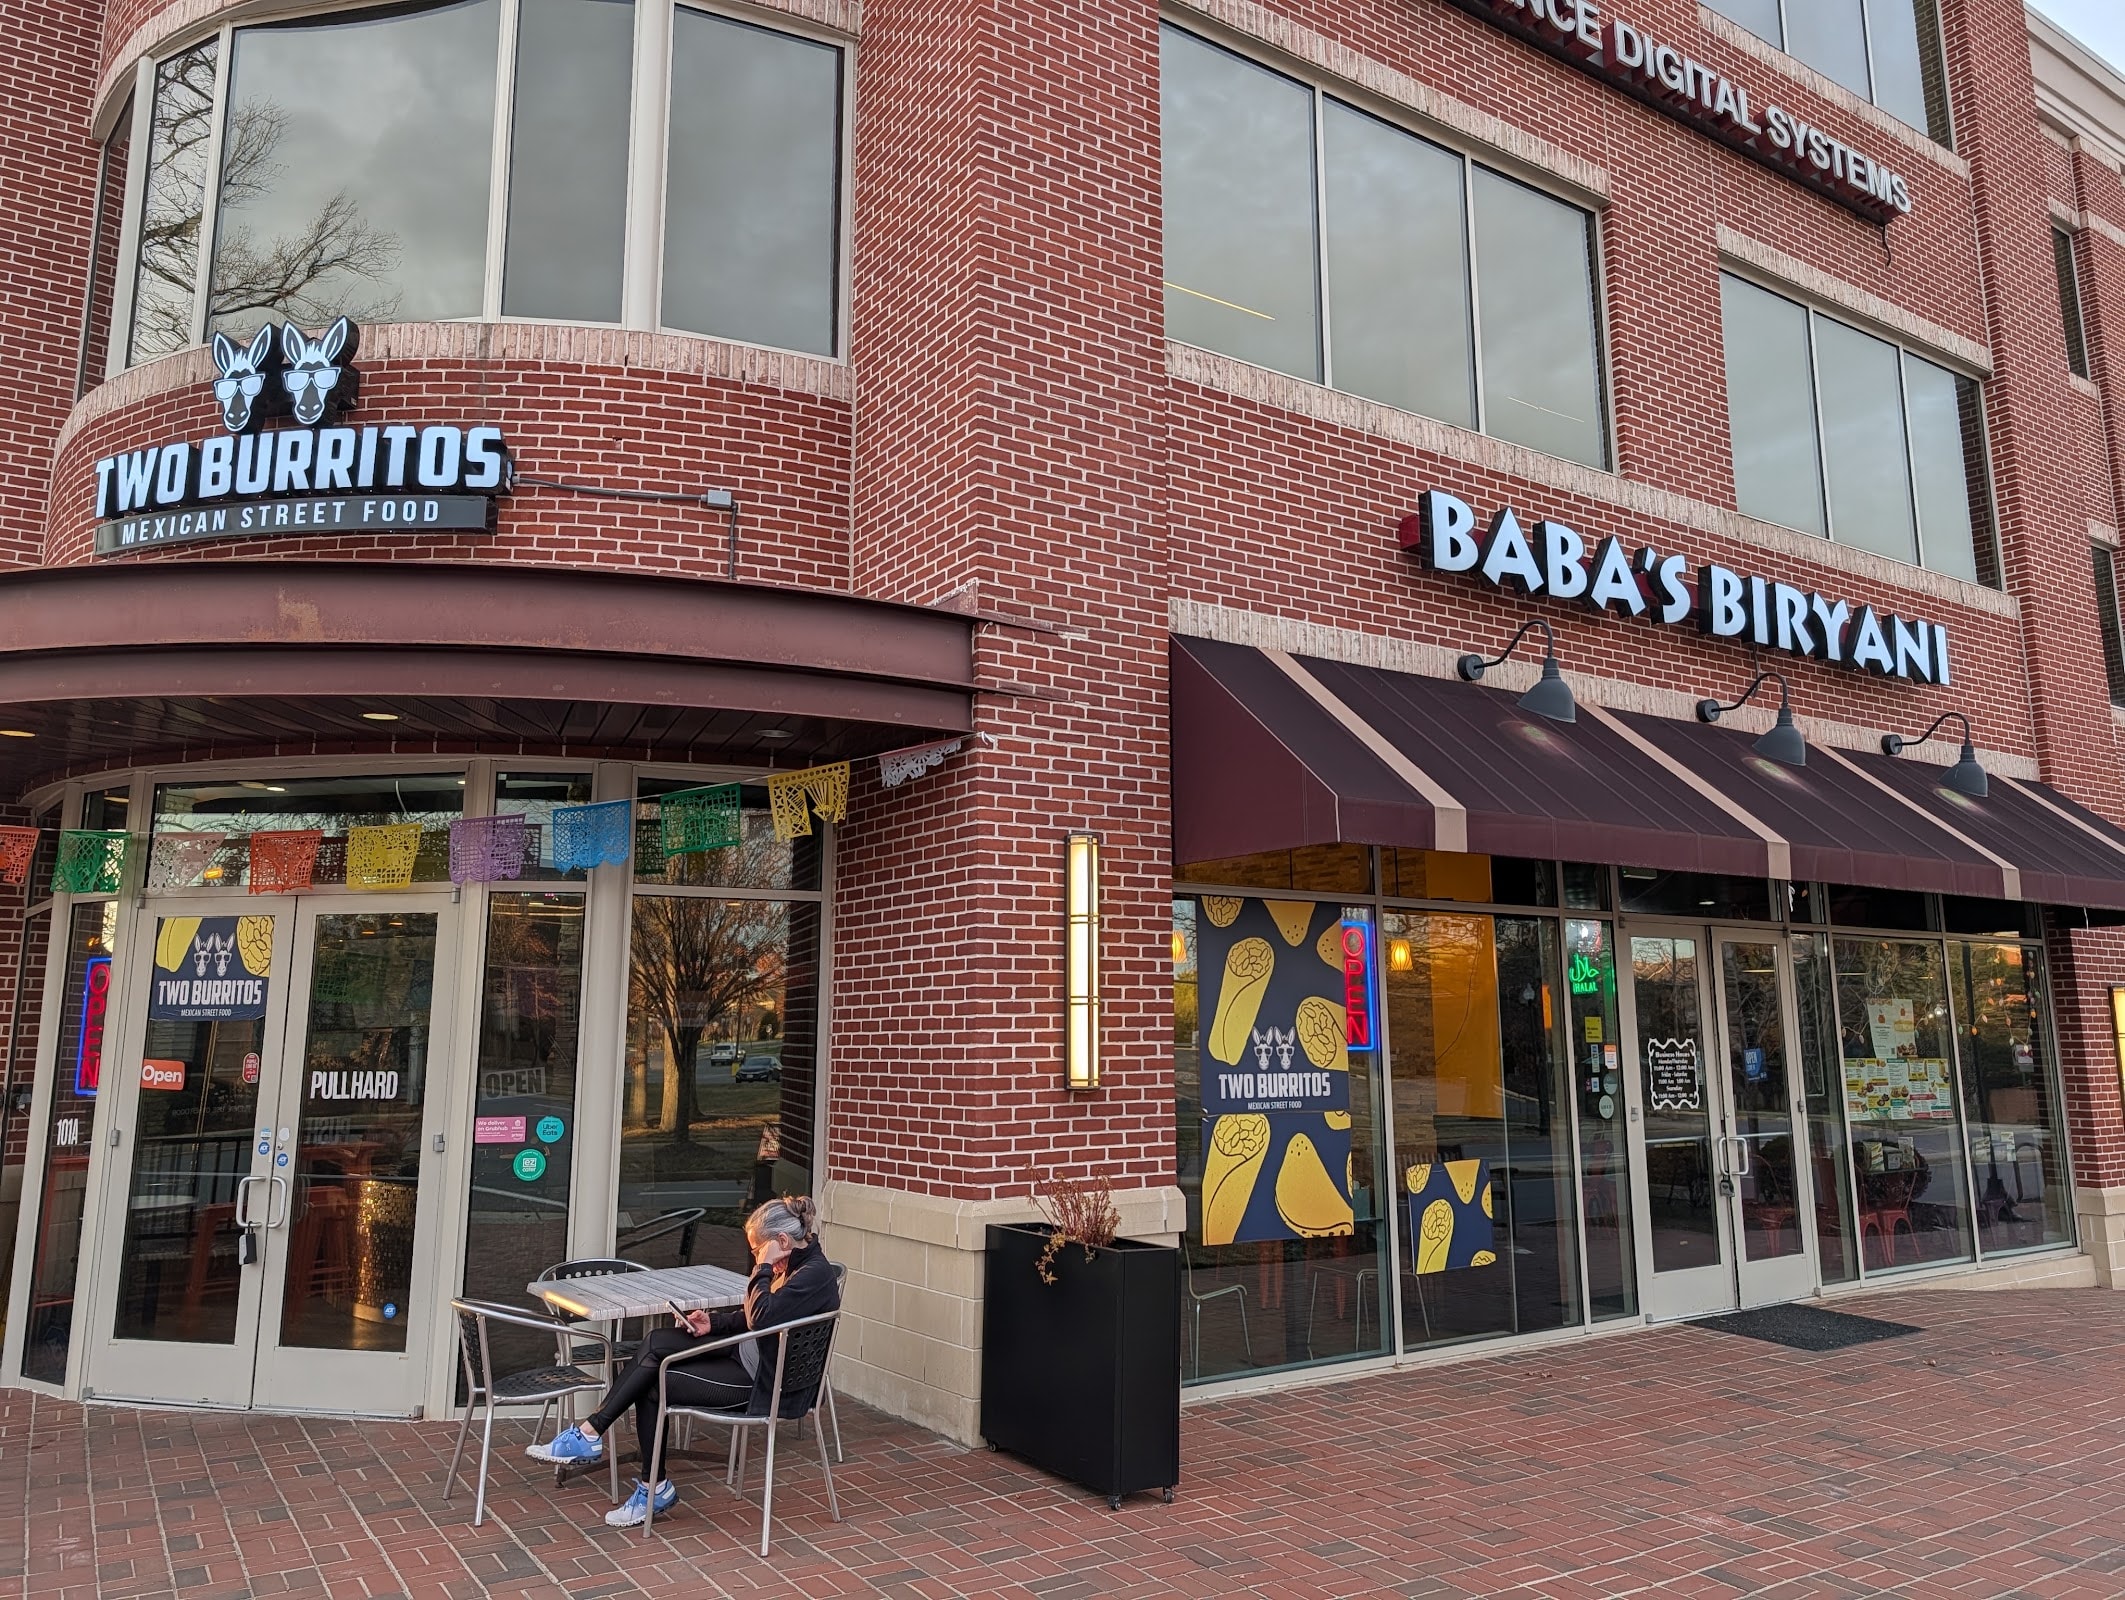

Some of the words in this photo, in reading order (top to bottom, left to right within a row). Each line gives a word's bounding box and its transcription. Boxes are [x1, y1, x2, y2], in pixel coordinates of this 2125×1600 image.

[1614, 18, 1762, 136] DIGITAL
[1765, 104, 1912, 214] SYSTEMS
[95, 443, 191, 519] TWO
[198, 426, 502, 500] BURRITOS
[121, 512, 227, 545] MEXICAN
[240, 501, 345, 530] STREET
[363, 500, 440, 524] FOOD
[1429, 489, 1691, 625] BABA'S
[1711, 565, 1950, 687] BIRYANI
[158, 980, 190, 1005] TWO
[191, 979, 263, 1005] BURRITOS
[1341, 928, 1369, 1045] OPEN
[1573, 981, 1599, 995] HALAL
[80, 964, 111, 1088] OPEN
[180, 1008, 201, 1017] MEXICAN
[201, 1008, 219, 1017] STREET
[219, 1008, 232, 1017] FOOD
[142, 1065, 183, 1086] Open
[310, 1070, 350, 1100] PULL
[350, 1070, 399, 1100] HARD
[485, 1069, 543, 1099] OPEN
[1218, 1073, 1255, 1100] TWO
[1256, 1072, 1331, 1099] BURRITOS
[1247, 1102, 1270, 1110] MEXICAN
[1270, 1101, 1288, 1110] STREET
[1288, 1100, 1303, 1109] FOOD
[56, 1118, 79, 1146] 101A
